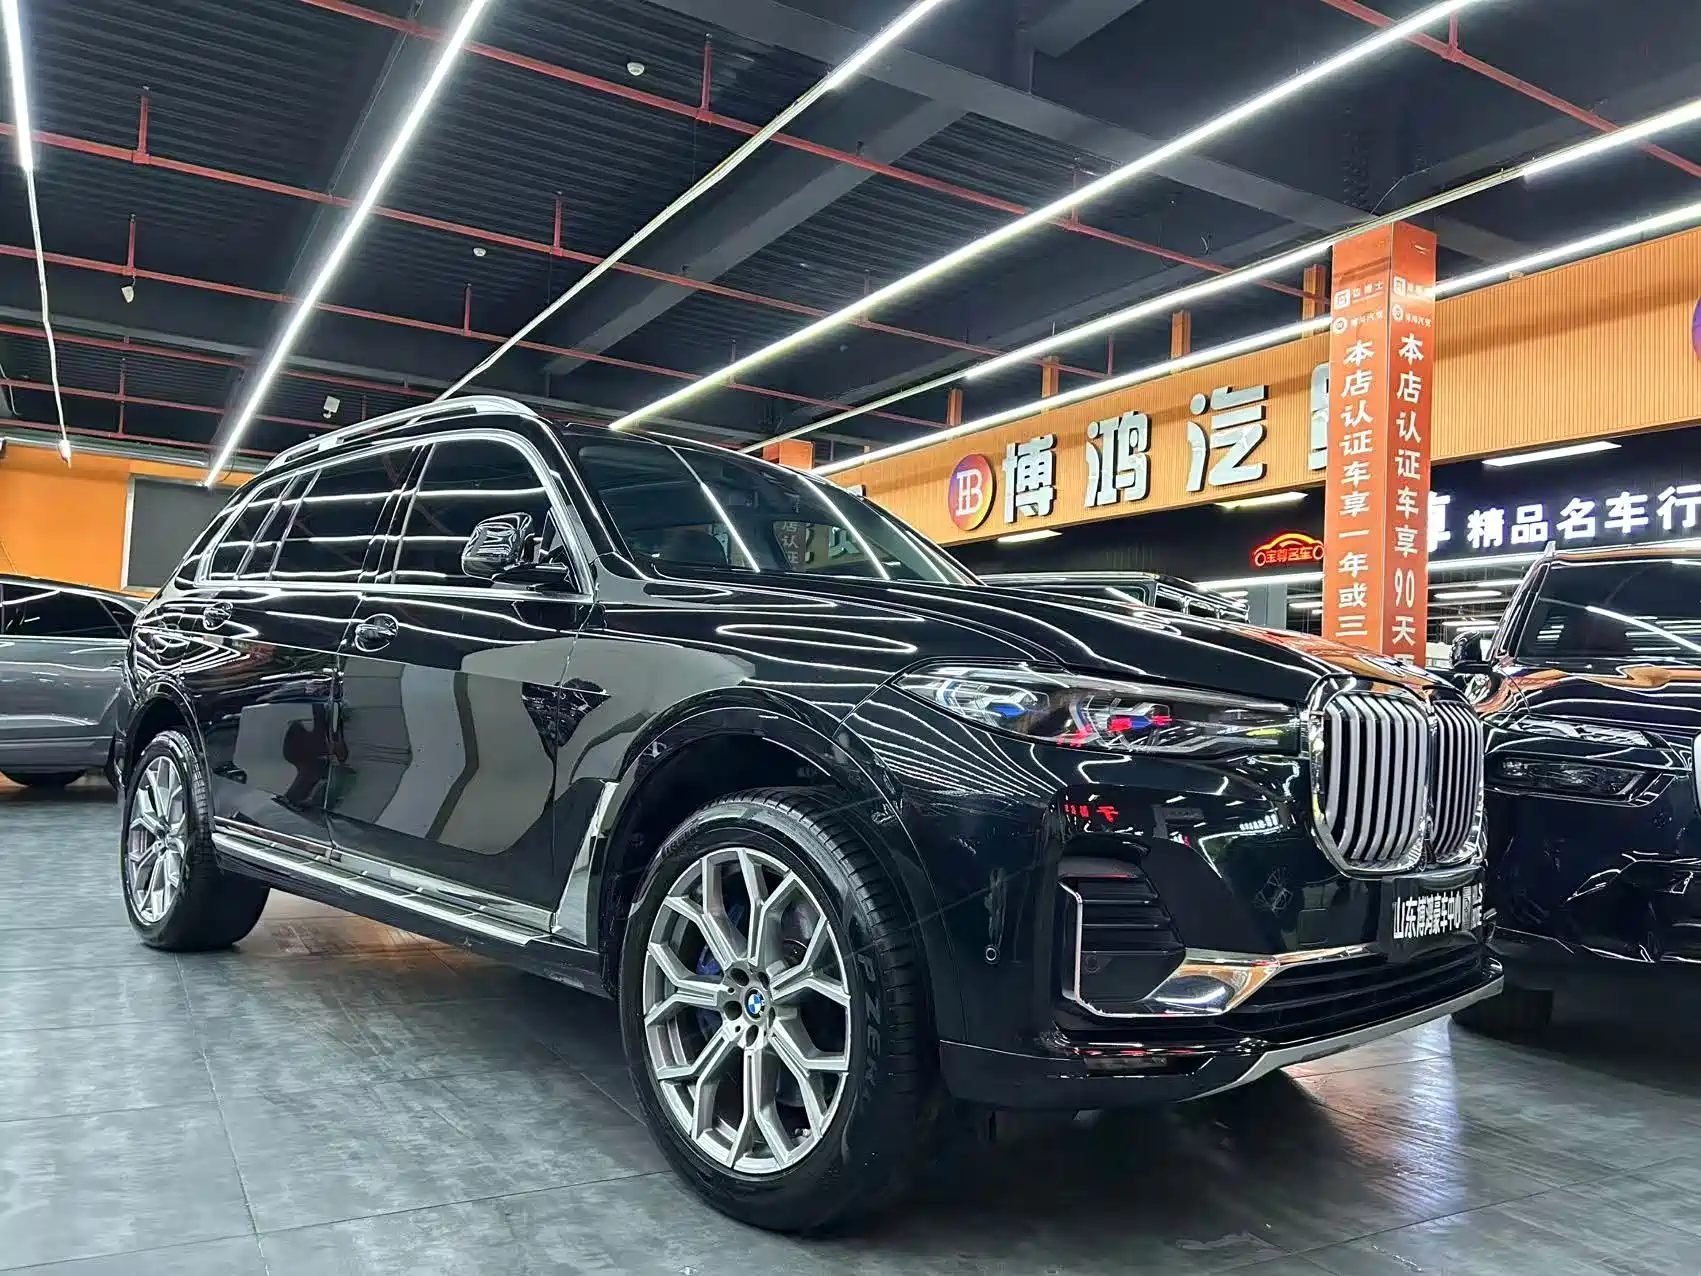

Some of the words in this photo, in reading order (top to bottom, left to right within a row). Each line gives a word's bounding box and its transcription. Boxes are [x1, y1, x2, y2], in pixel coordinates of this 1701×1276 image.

[1336, 340, 1375, 637] 本店认证车享一年或三
[1467, 483, 1701, 548] 精品名车行
